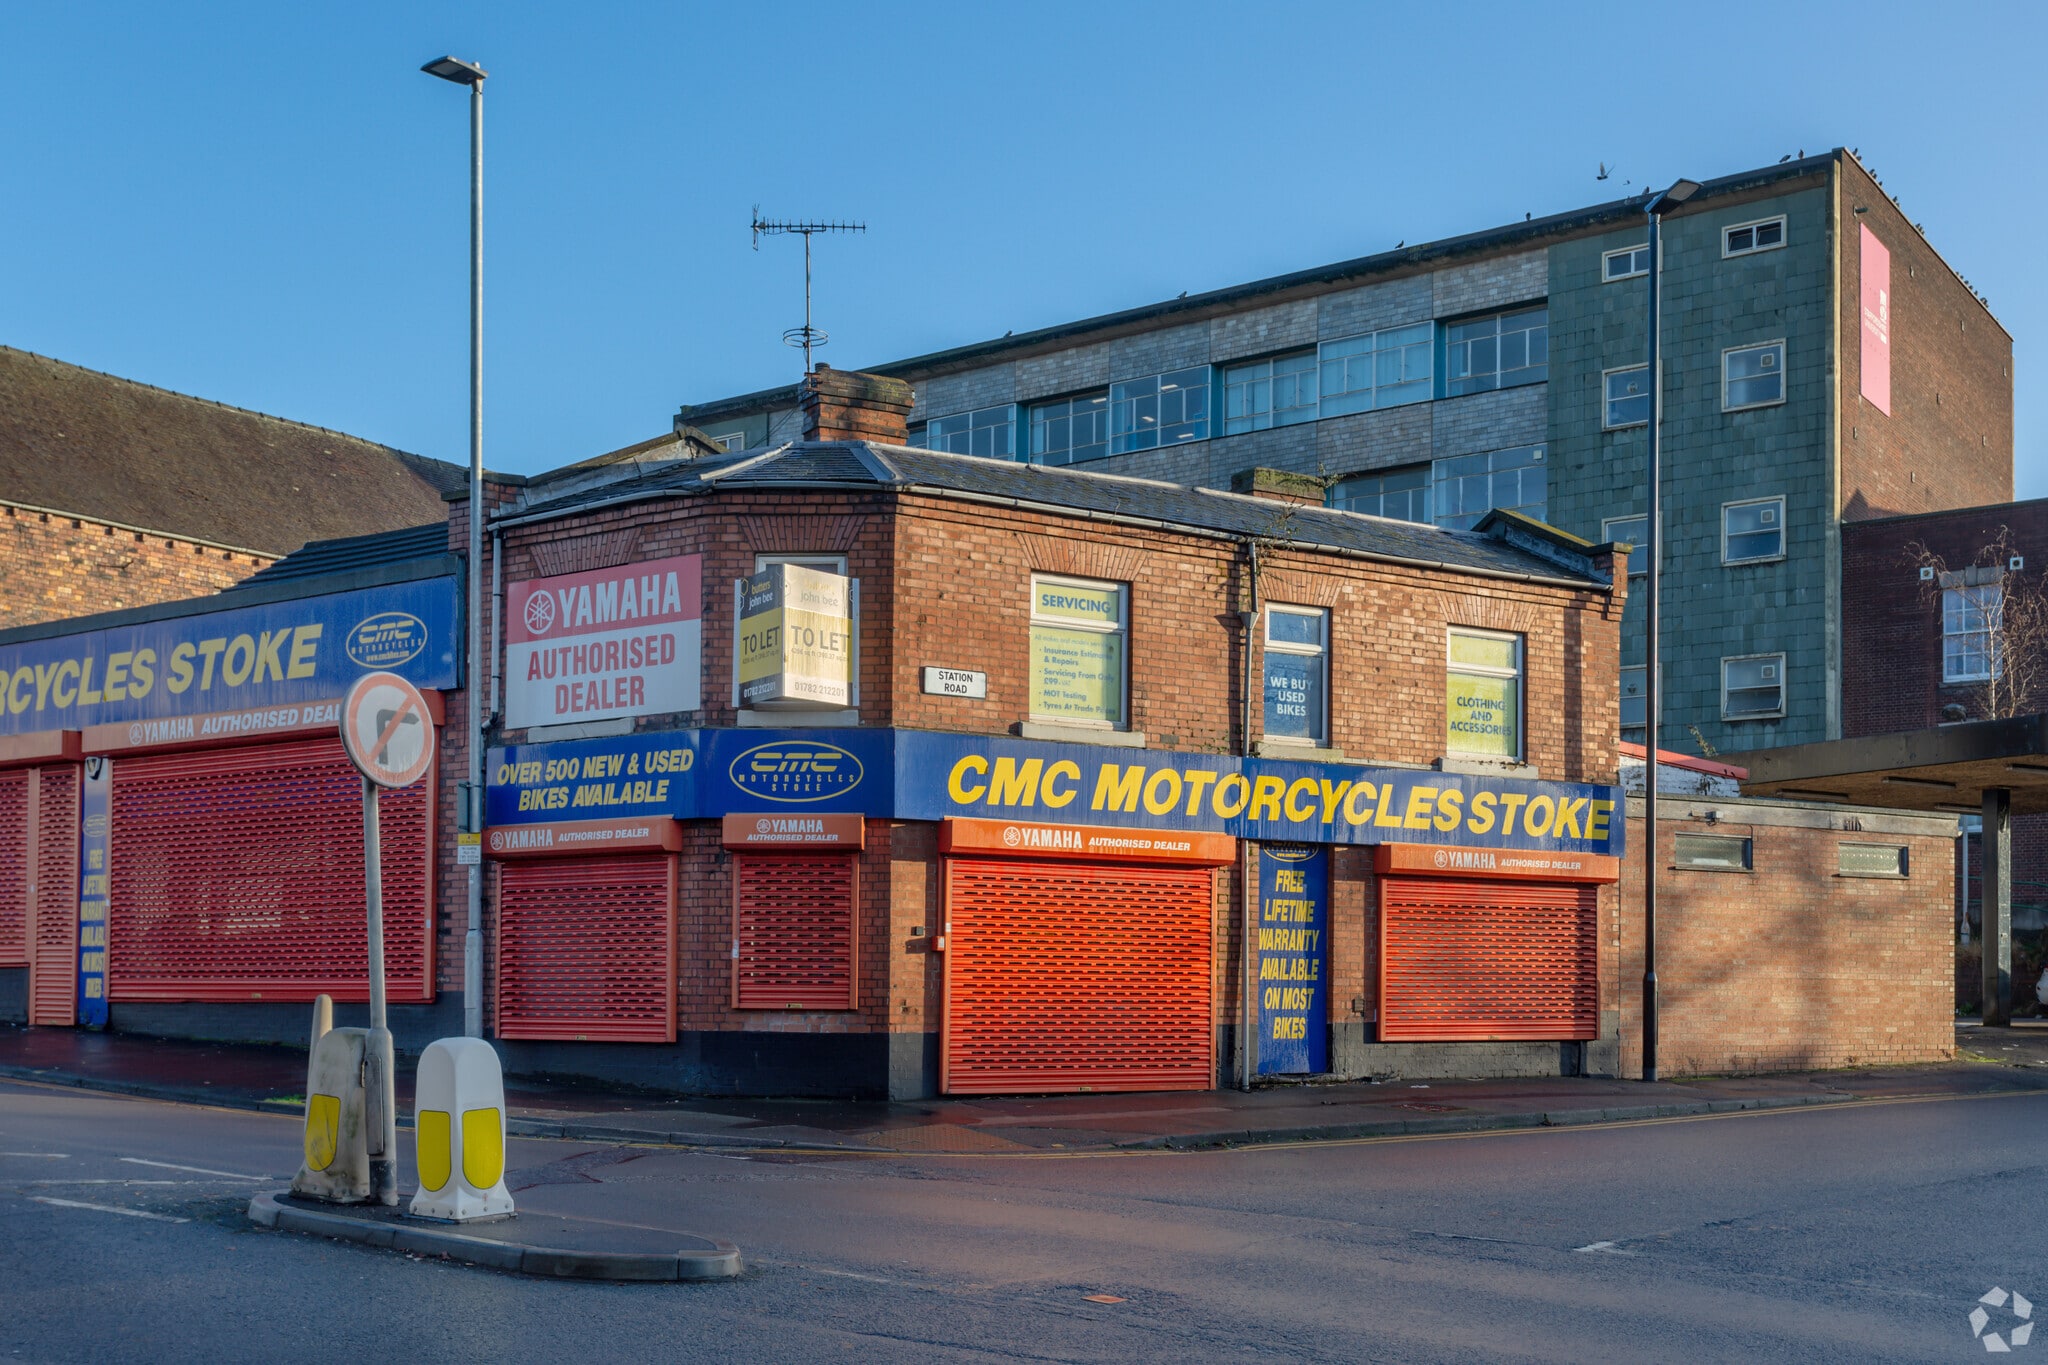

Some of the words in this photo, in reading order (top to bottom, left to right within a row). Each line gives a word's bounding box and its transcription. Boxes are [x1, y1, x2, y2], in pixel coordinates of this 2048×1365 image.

[751, 581, 771, 593] butters
[558, 571, 682, 629] YAMAHA
[748, 595, 762, 611] john
[762, 592, 774, 603] bee
[800, 592, 820, 604] john
[822, 593, 839, 607] bee
[1042, 594, 1111, 613] SERVICING
[742, 633, 757, 655] TO
[760, 626, 780, 650] LET
[791, 625, 815, 647] TO
[819, 630, 850, 653] LET
[167, 623, 323, 695] STOKE
[527, 633, 675, 681] AUTHORISED
[1043, 646, 1079, 657] Insurance
[1043, 655, 1050, 663] &
[1051, 656, 1079, 667] Repairs
[938, 671, 973, 683] STATION
[1043, 668, 1076, 679] Servicing
[1078, 671, 1096, 680] From
[743, 685, 759, 698] 01782
[794, 681, 817, 694] 01782
[819, 684, 845, 697] 212201
[944, 683, 968, 694] ROAD
[1270, 676, 1288, 689] WE
[1291, 678, 1313, 691] BUY
[555, 675, 645, 715] DEALER
[1043, 690, 1060, 698] MOT
[1062, 690, 1087, 702] Testing
[1278, 690, 1305, 703] USED
[1456, 696, 1506, 711] CLOTHING
[1043, 701, 1062, 711] Tyres
[1064, 703, 1073, 711] At
[1074, 704, 1094, 712] Trade
[1277, 703, 1306, 717] BIKES
[1470, 711, 1493, 722] AND
[144, 718, 194, 743] YAMAHA
[201, 708, 299, 735] AUTHORISED
[1450, 721, 1512, 737] ACCESSORIES
[497, 762, 543, 786] OVER
[545, 757, 580, 782] 500
[582, 754, 625, 779] NEW
[627, 753, 639, 775] &
[644, 748, 694, 774] USED
[738, 774, 855, 783] MOTORCYCLES
[518, 785, 570, 812] BIKES
[571, 779, 670, 808] AVAILABLE
[771, 783, 821, 792] STOKE
[947, 754, 1082, 809] CMC
[1090, 763, 1465, 831] MOTORCYCLES
[1466, 790, 1614, 840] STOKE
[772, 819, 824, 833] YAMAHA
[504, 828, 554, 849] YAMAHA
[558, 829, 613, 842] AUTHORISED
[614, 827, 650, 839] DEALER
[747, 833, 802, 841] AUTHORISED
[804, 833, 838, 841] DEALER
[1022, 828, 1083, 849] YAMAHA
[1088, 836, 1152, 849] AUTHORISED
[1153, 839, 1191, 851] DEALER
[1449, 851, 1497, 869] YAMAHA
[1501, 858, 1550, 869] AUTHORISED
[1551, 860, 1581, 870] DEALER
[1275, 869, 1305, 893] FREE
[1264, 899, 1316, 922] LIFETIME
[1258, 928, 1320, 952] WARRANTY
[1259, 957, 1320, 981] AVAILABLE
[1264, 987, 1281, 1010] ON
[1281, 987, 1315, 1011] MOST
[1273, 1016, 1306, 1039] BIKES
